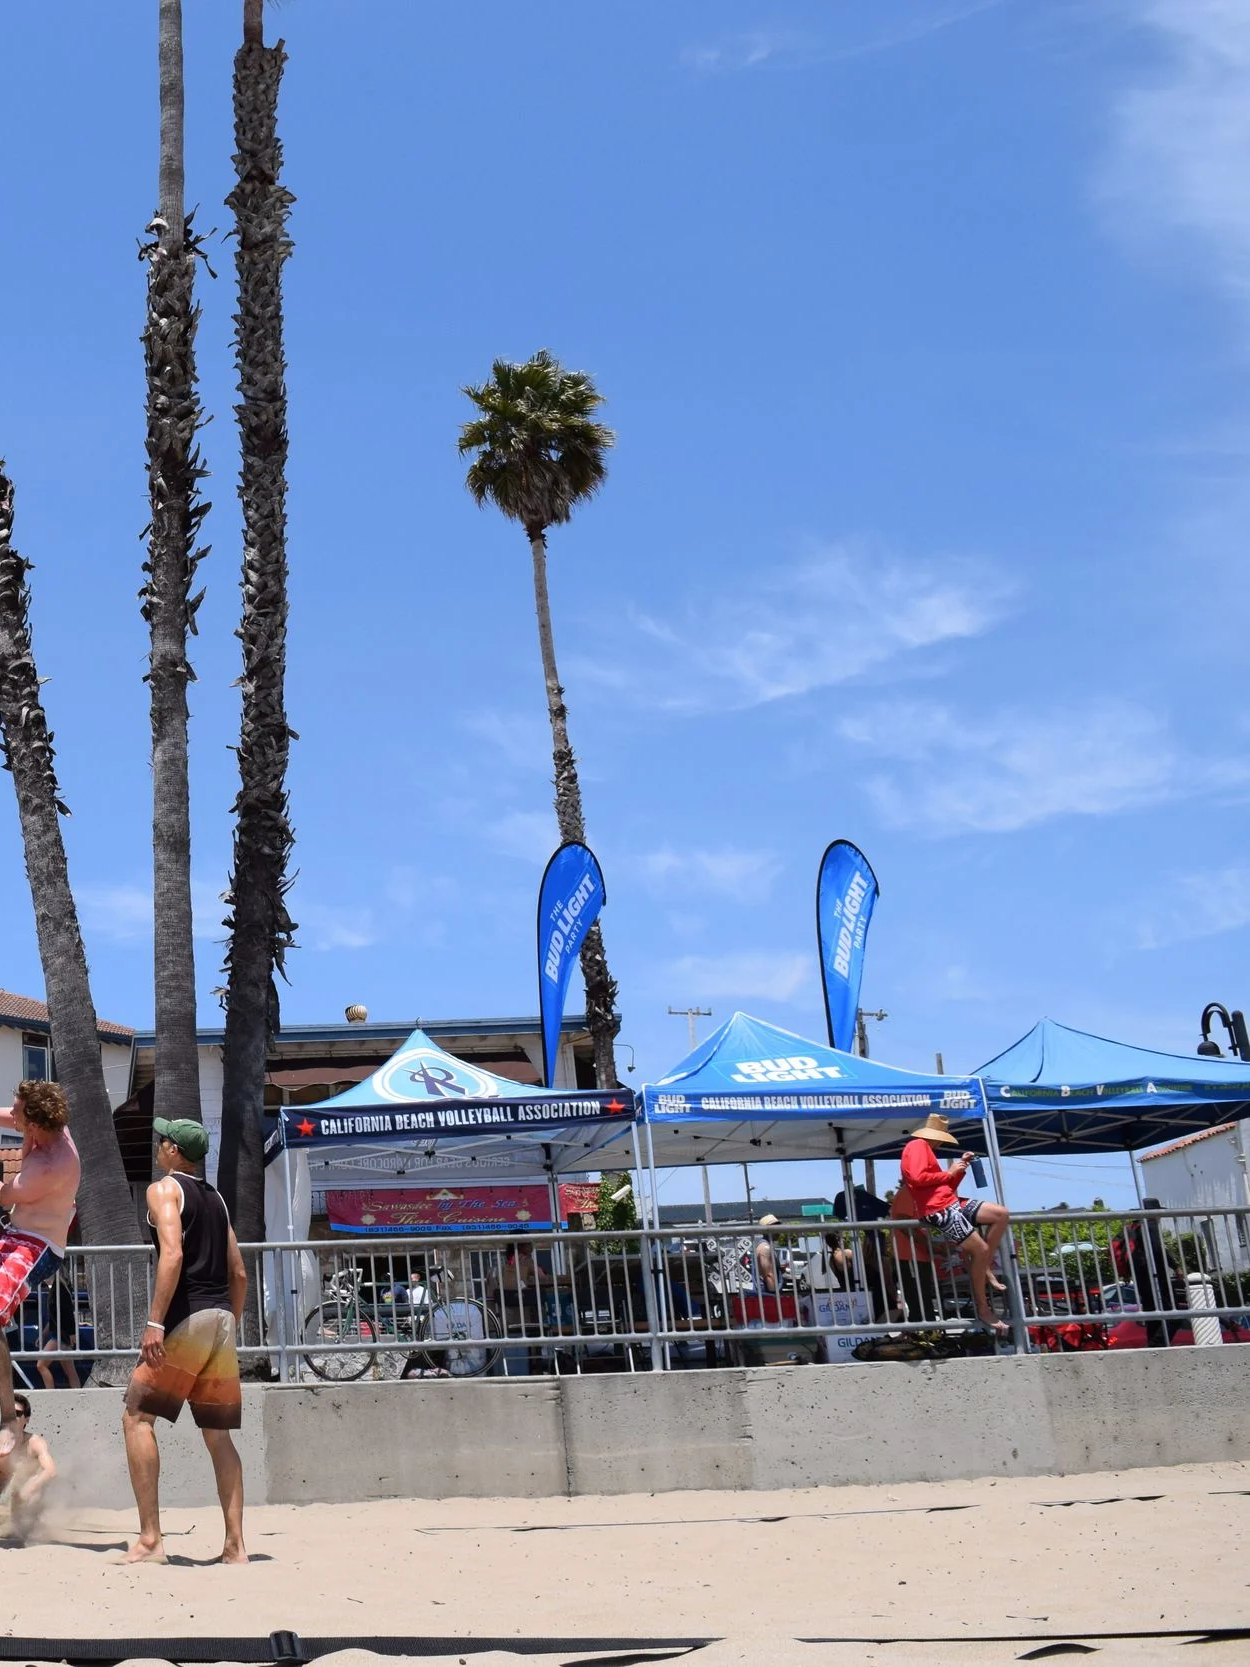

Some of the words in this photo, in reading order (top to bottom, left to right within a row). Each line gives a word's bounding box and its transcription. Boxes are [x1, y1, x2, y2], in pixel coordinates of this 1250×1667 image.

[842, 870, 869, 932] LIGHT
[550, 899, 564, 922] THE
[544, 929, 564, 983] BUD
[557, 872, 595, 936] LIGHT
[565, 918, 583, 954] PARTY
[853, 915, 867, 949] PARTY
[833, 927, 852, 979] BUD
[735, 1056, 819, 1074] BUD
[731, 1066, 841, 1083] LIGHT
[658, 1094, 686, 1105] BUD
[701, 1096, 763, 1110] CALIFORNIA
[763, 1096, 798, 1110] BEACH
[801, 1095, 861, 1110] VOLLEYBALL
[862, 1094, 931, 1108] ASSOCIATION
[940, 1099, 976, 1109] LIGHT
[944, 1090, 971, 1100] BUD
[321, 1115, 392, 1135] CALIFORNIA
[395, 1112, 435, 1130] BEACH
[438, 1106, 514, 1126] VOLLEYBALL
[518, 1101, 600, 1121] ASSOCIATION
[654, 1104, 692, 1114] LIGHT
[387, 1212, 433, 1224] Thai
[438, 1212, 507, 1224] Cuisine
